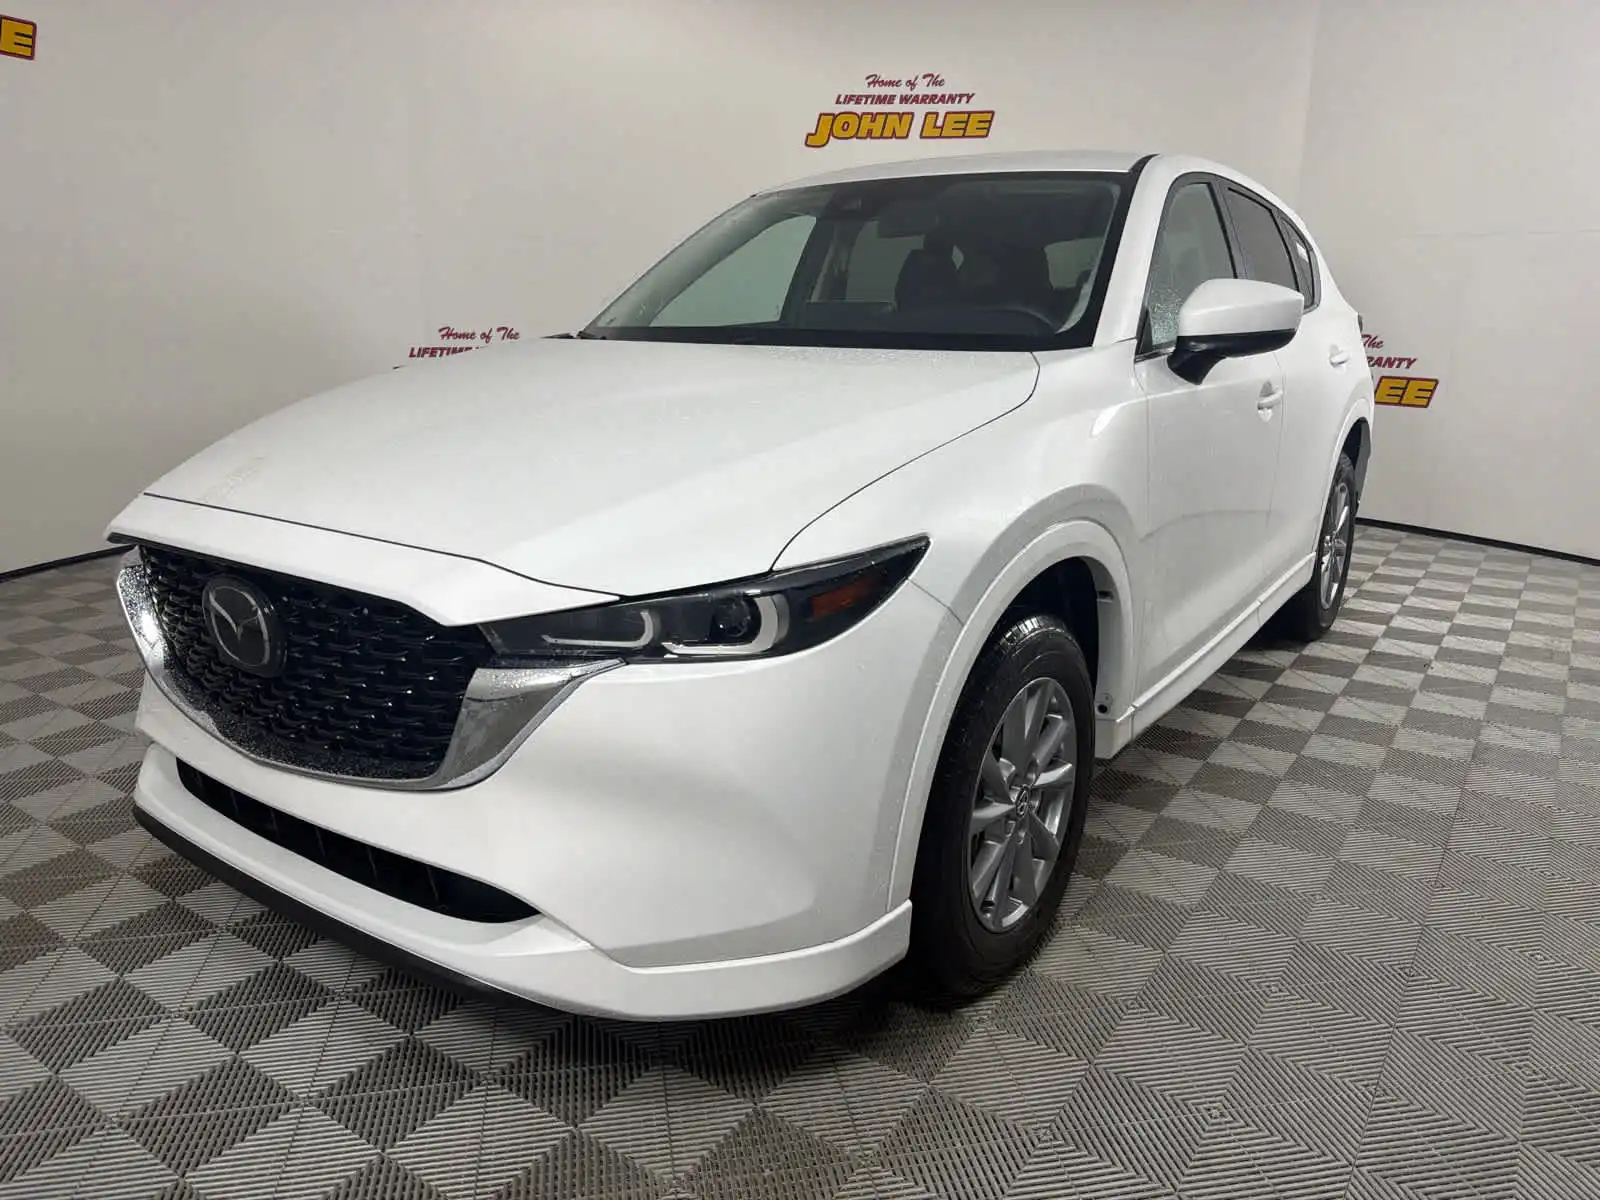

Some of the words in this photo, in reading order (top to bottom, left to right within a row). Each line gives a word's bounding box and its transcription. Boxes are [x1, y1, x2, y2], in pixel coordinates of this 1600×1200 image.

[865, 73, 902, 88] Home
[905, 75, 919, 91] of
[922, 73, 945, 88] The
[835, 93, 896, 105] LIFETIME
[899, 93, 976, 105] WARRANTY
[805, 111, 915, 148] JOHN
[919, 110, 995, 139] LEE
[438, 326, 477, 341] Home
[479, 327, 493, 344] of
[496, 326, 520, 341] The
[1361, 333, 1384, 349] The
